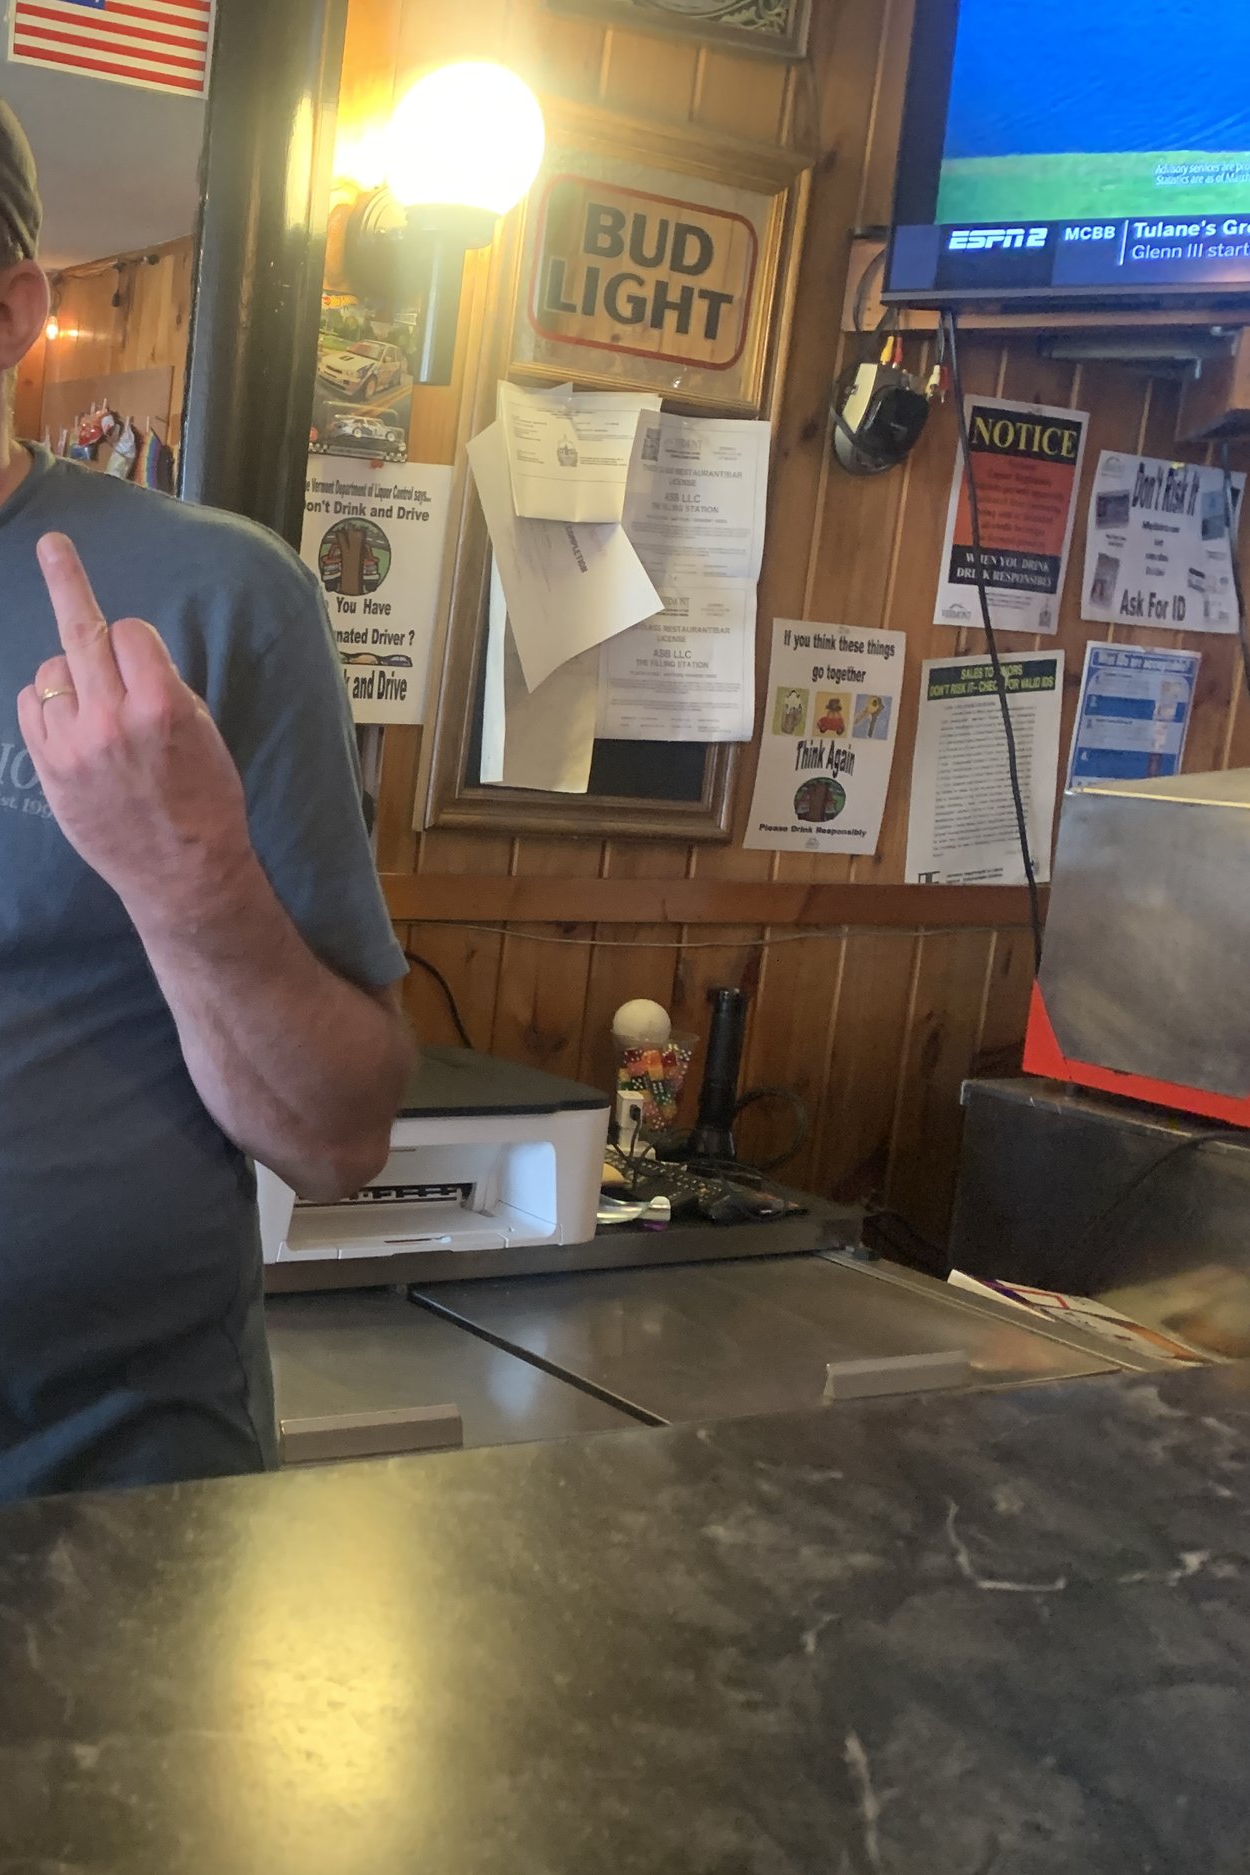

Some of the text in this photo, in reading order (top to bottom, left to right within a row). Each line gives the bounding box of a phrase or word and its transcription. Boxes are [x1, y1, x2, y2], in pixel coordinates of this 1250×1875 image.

[583, 202, 715, 276] BUD
[1065, 226, 1115, 241] MCBB
[1134, 220, 1216, 238] Tulane's
[1131, 244, 1183, 260] Glenn
[546, 257, 735, 340] LIGHT
[972, 416, 1077, 459] NOTICE
[305, 500, 430, 521] on't Drink and Drive
[957, 567, 989, 579] DRIK
[336, 597, 391, 616] You Have
[1120, 589, 1186, 621] Ask For ID
[371, 628, 405, 646] Driver
[408, 629, 415, 646] ?
[783, 629, 895, 660] If you think these things
[673, 650, 692, 659] LLC
[811, 665, 867, 685] go together
[352, 670, 375, 699] and
[377, 670, 408, 701] Drive
[795, 739, 856, 779] Think Again
[759, 823, 867, 838] Please Drink Responsibly
